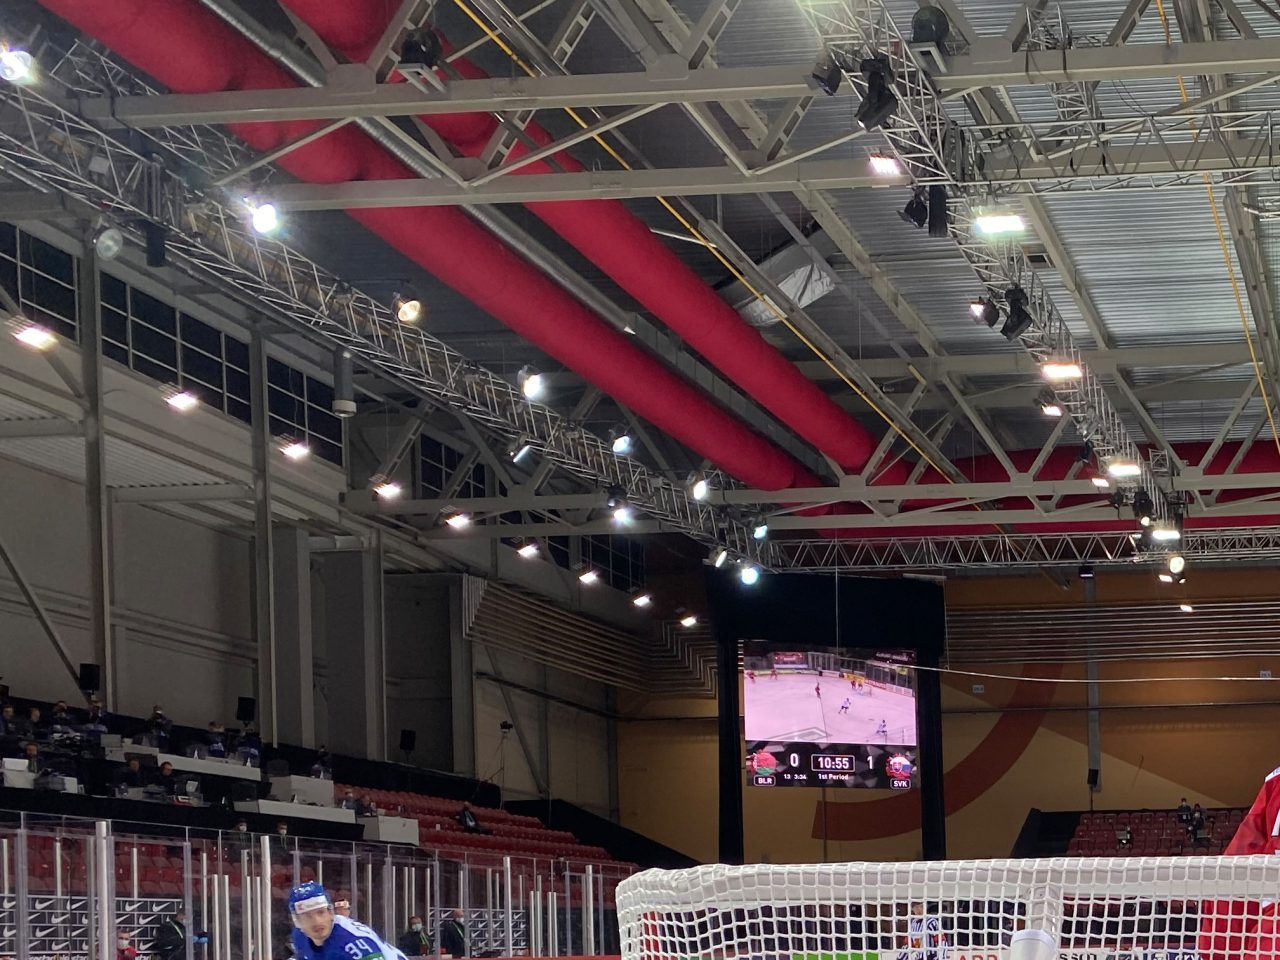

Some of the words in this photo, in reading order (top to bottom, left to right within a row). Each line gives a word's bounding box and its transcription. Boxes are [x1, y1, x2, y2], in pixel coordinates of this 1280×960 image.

[790, 753, 799, 767] 0
[818, 757, 850, 769] 10:55
[867, 756, 873, 770] 1
[758, 777, 773, 785] BLR
[345, 939, 373, 960] 34
